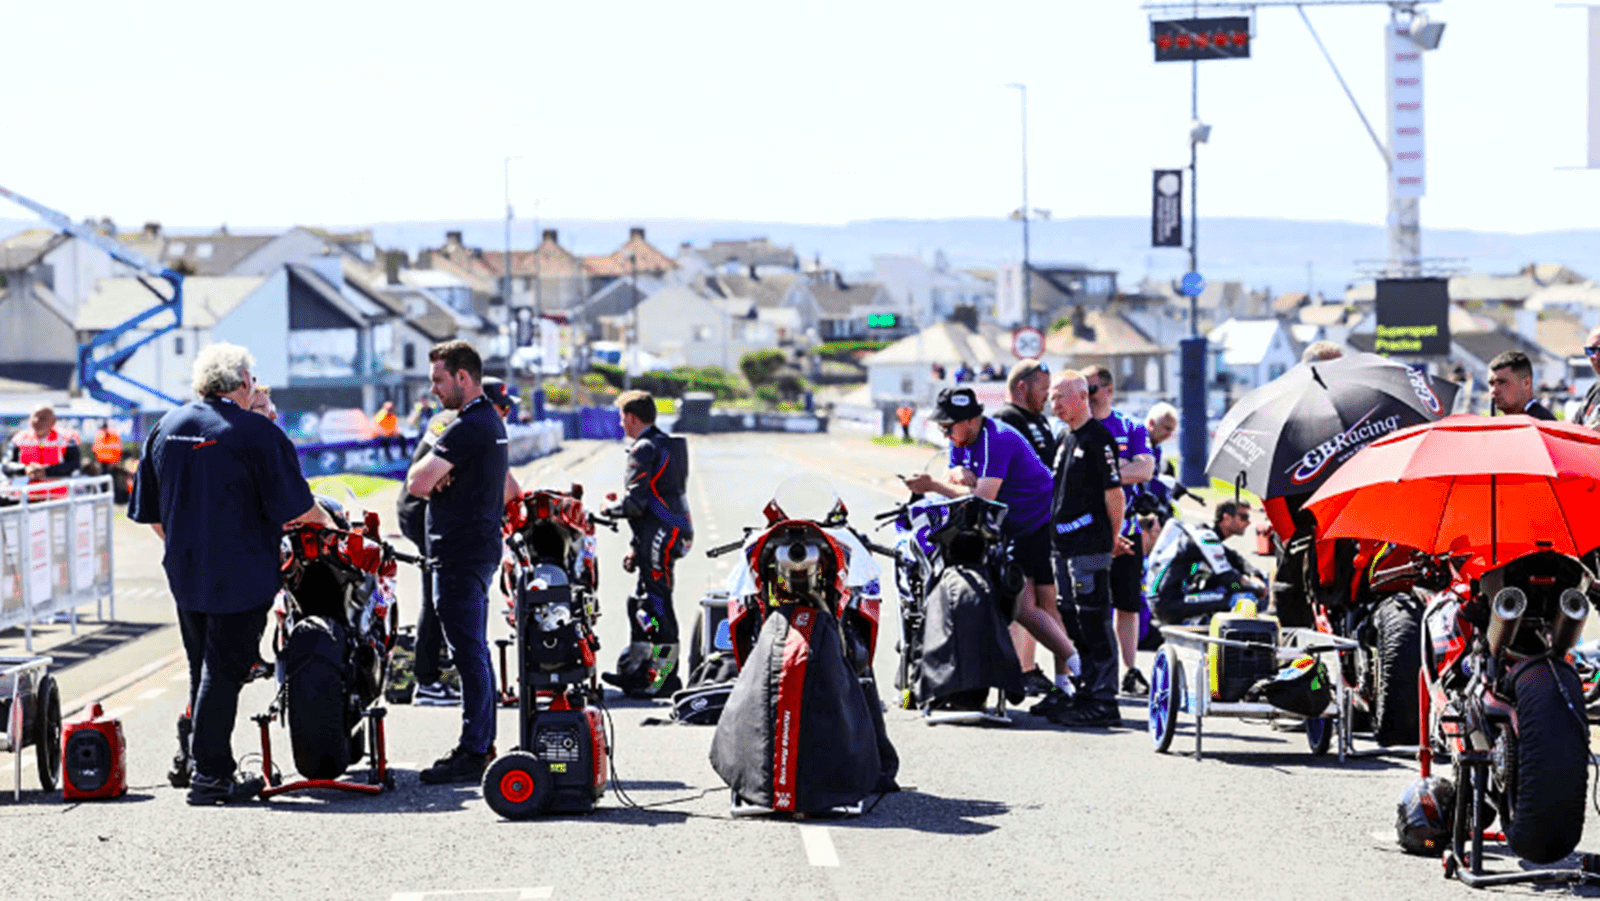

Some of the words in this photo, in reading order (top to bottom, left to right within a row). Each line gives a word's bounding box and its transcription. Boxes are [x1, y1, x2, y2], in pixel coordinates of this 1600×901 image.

[1302, 415, 1399, 468] GBRacing
[782, 709, 791, 747] Honda
[778, 747, 789, 786] Racing
